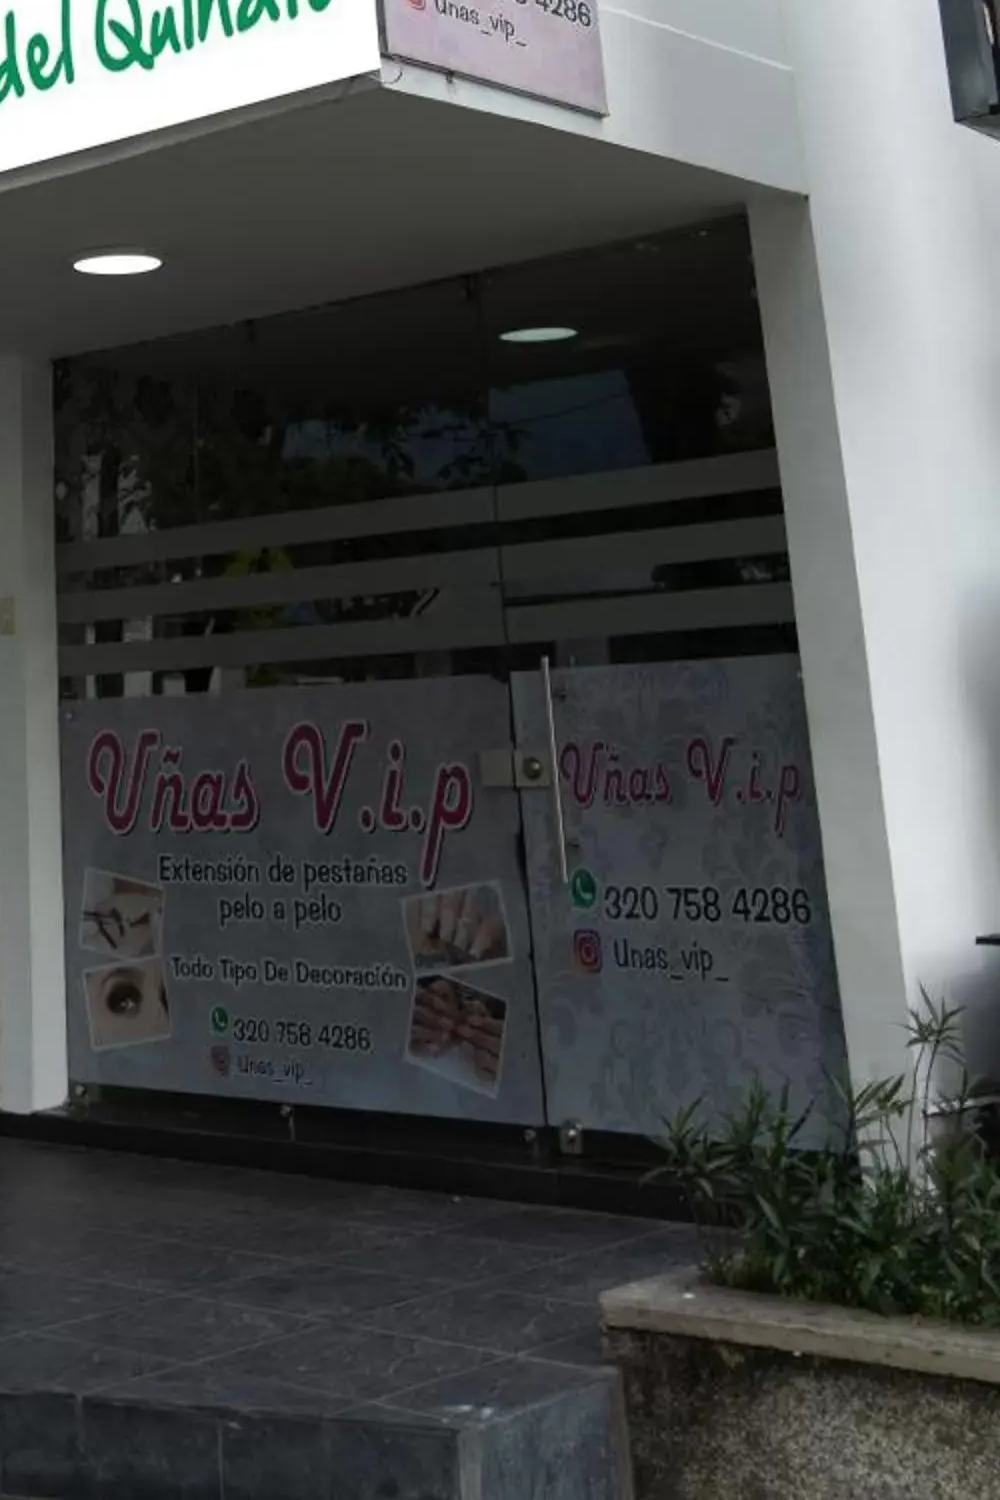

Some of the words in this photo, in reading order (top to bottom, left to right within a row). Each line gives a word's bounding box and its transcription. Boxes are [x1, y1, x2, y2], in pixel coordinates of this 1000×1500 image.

[87, 729, 261, 835] Uñas
[560, 742, 672, 809] Uñas
[159, 856, 260, 883] Extensión
[269, 855, 295, 883] de
[303, 858, 408, 892] pestañas
[219, 893, 265, 926] pelo
[273, 902, 285, 920] a
[294, 894, 342, 929] pelo
[604, 886, 658, 920] 320
[667, 887, 722, 922] 758
[732, 888, 812, 924] 4286
[173, 956, 213, 978] Todo
[220, 958, 257, 985] Tipo
[265, 960, 288, 981] De
[296, 962, 407, 988] Decoración
[233, 1019, 270, 1043] 320
[275, 1022, 312, 1046] 758
[318, 1025, 371, 1050] 4286
